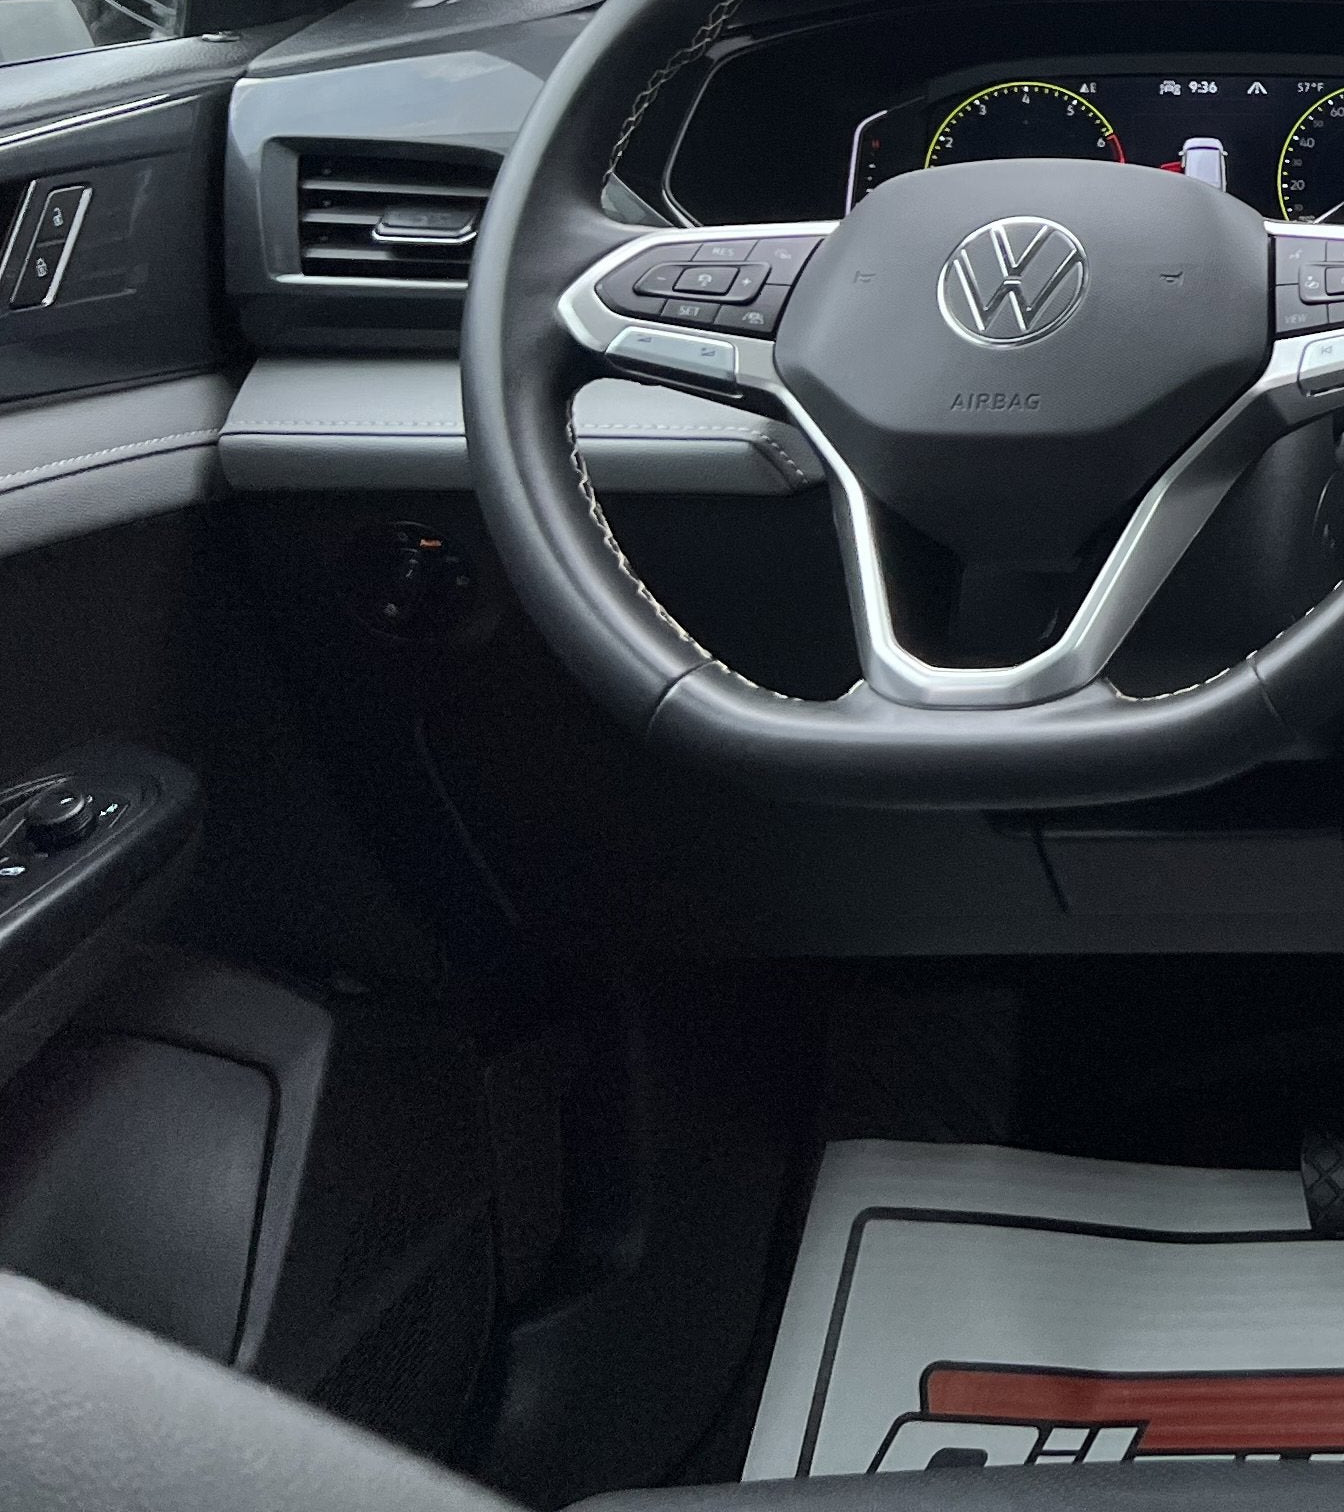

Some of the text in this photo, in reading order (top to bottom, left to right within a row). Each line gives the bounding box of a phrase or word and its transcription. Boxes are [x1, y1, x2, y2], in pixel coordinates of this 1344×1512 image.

[1188, 81, 1218, 94] 9:36
[1021, 93, 1031, 105] 4
[978, 104, 988, 116] 3
[1066, 104, 1075, 117] 5
[945, 136, 955, 149] 2
[1096, 137, 1105, 149] 6
[1299, 137, 1316, 149] 40
[1290, 179, 1306, 192] 20
[711, 246, 735, 257] RES
[679, 305, 701, 318] SET
[950, 392, 1041, 412] AIRBAG
